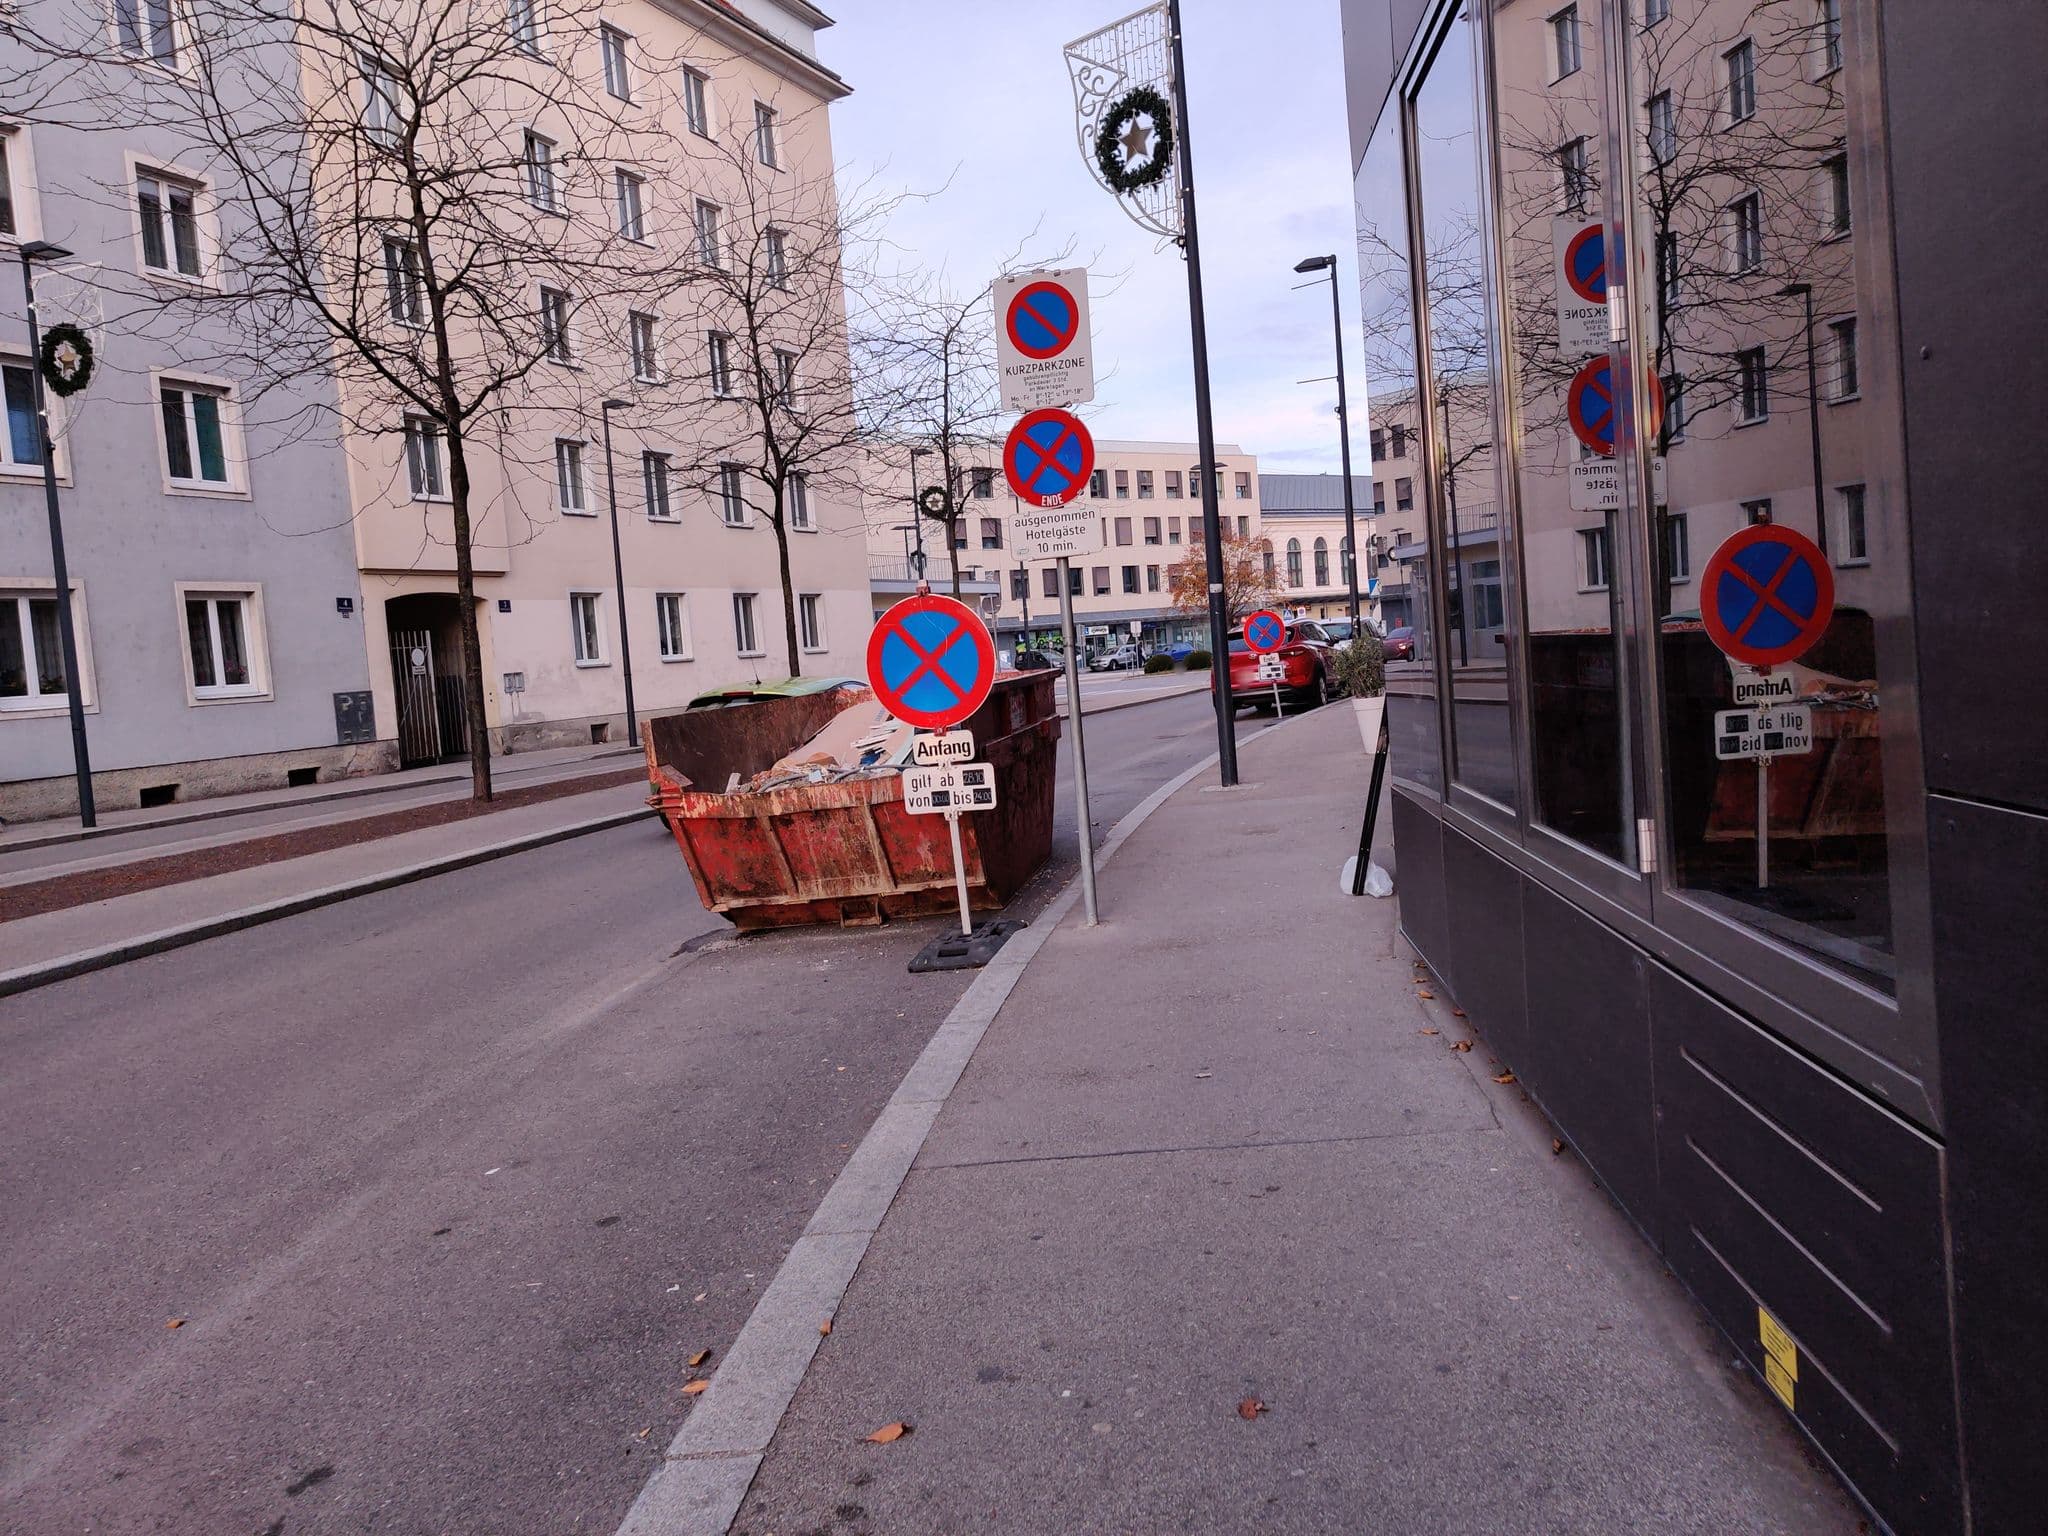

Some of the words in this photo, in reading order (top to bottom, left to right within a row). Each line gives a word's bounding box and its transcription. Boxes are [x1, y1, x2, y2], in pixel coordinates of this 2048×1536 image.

[1005, 357, 1085, 377] KURZPARKZONE
[1041, 493, 1064, 507] ENDE
[1014, 510, 1095, 528] ausgenommen
[1026, 526, 1086, 541] Hotelgäste
[1037, 542, 1049, 553] 10
[1053, 541, 1077, 552] min.
[917, 740, 971, 758] Anfang
[911, 774, 932, 792] gilt
[940, 773, 955, 787] ab
[908, 796, 930, 808] von
[953, 791, 972, 805] bis
